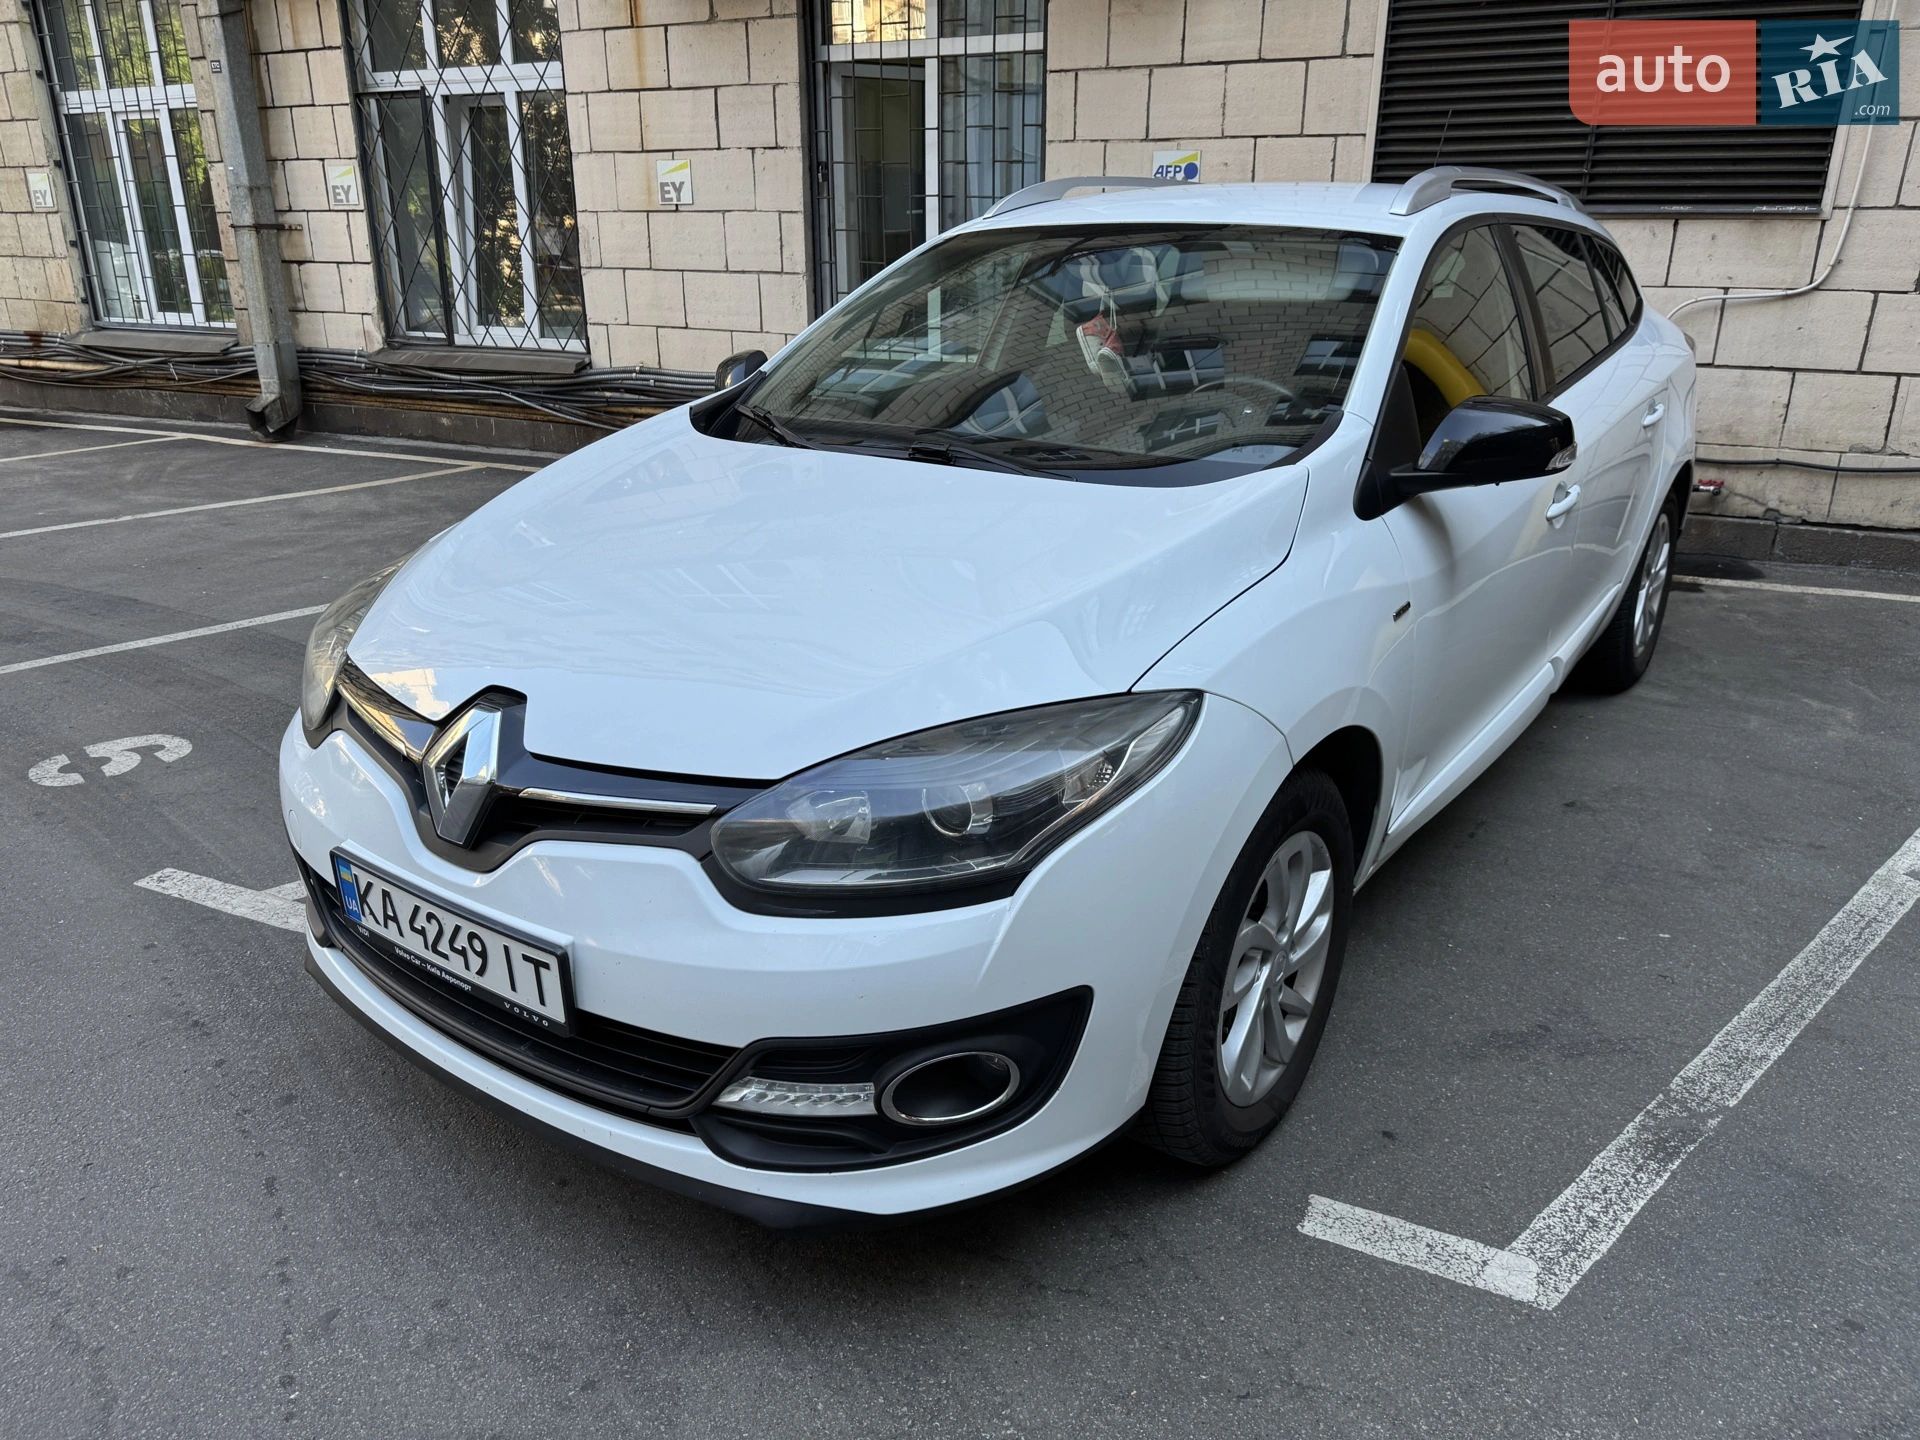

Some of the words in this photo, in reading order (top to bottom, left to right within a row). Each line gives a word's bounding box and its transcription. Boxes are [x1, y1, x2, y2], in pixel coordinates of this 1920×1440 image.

[33, 189, 47, 206] EY
[332, 184, 351, 204] EY
[659, 181, 685, 203] EY
[345, 894, 359, 914] UA
[352, 871, 405, 939] KA
[408, 902, 489, 978] 4249
[503, 943, 551, 1007] IT
[394, 945, 410, 960] Volvo
[503, 1001, 549, 1027] VOLVO
